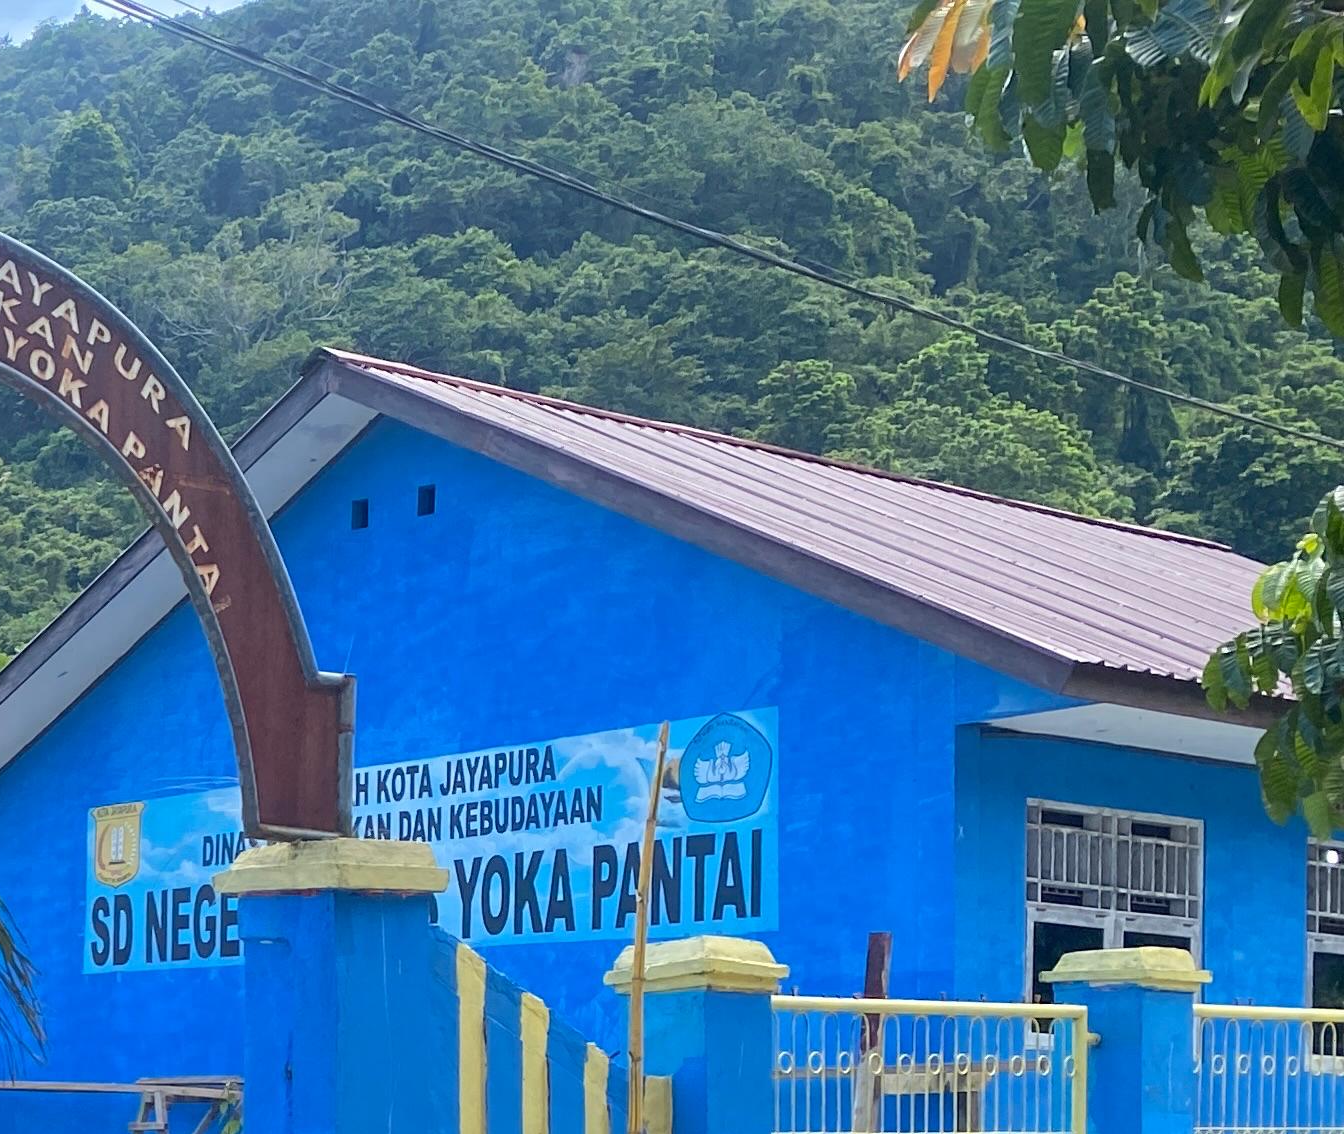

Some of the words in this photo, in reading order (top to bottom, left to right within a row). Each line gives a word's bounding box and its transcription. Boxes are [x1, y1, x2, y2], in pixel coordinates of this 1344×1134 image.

[2, 326, 110, 434] YOKA
[377, 764, 433, 804] KOTA
[439, 744, 557, 796] JAYAPURA
[202, 831, 258, 867] DINA
[399, 807, 443, 842] DAN
[449, 785, 603, 839] KEBUDAYAAN
[90, 894, 134, 967] SD
[145, 884, 241, 964] NEGE
[455, 848, 576, 939] YOKA
[592, 829, 762, 930] PANTAI
